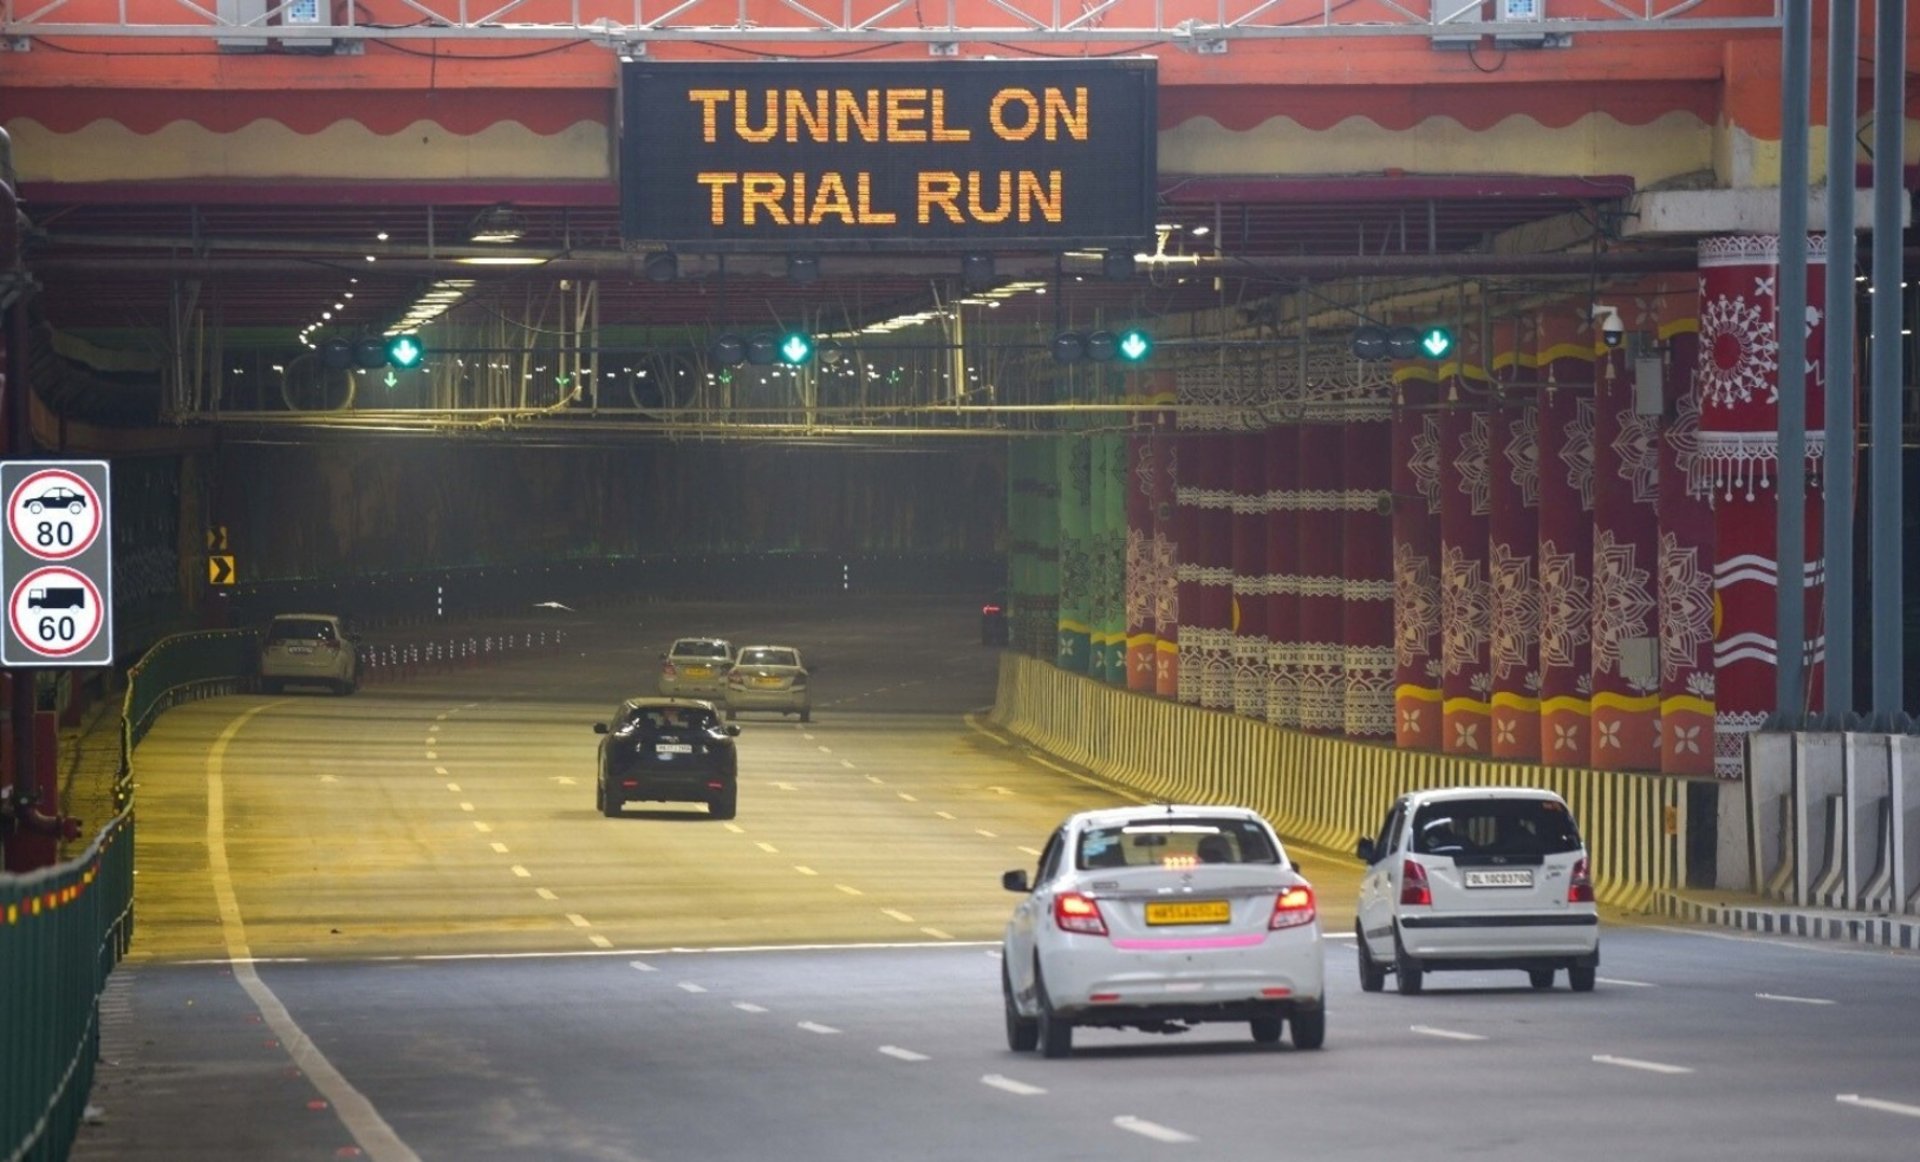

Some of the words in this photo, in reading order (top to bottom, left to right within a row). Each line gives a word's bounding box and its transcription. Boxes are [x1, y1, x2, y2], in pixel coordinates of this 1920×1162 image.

[688, 88, 971, 142] TUNNEL
[989, 87, 1088, 141] ON
[697, 171, 896, 224] TRIAL
[917, 171, 1062, 223] RUN
[37, 521, 73, 546] 80
[39, 616, 75, 641] 60
